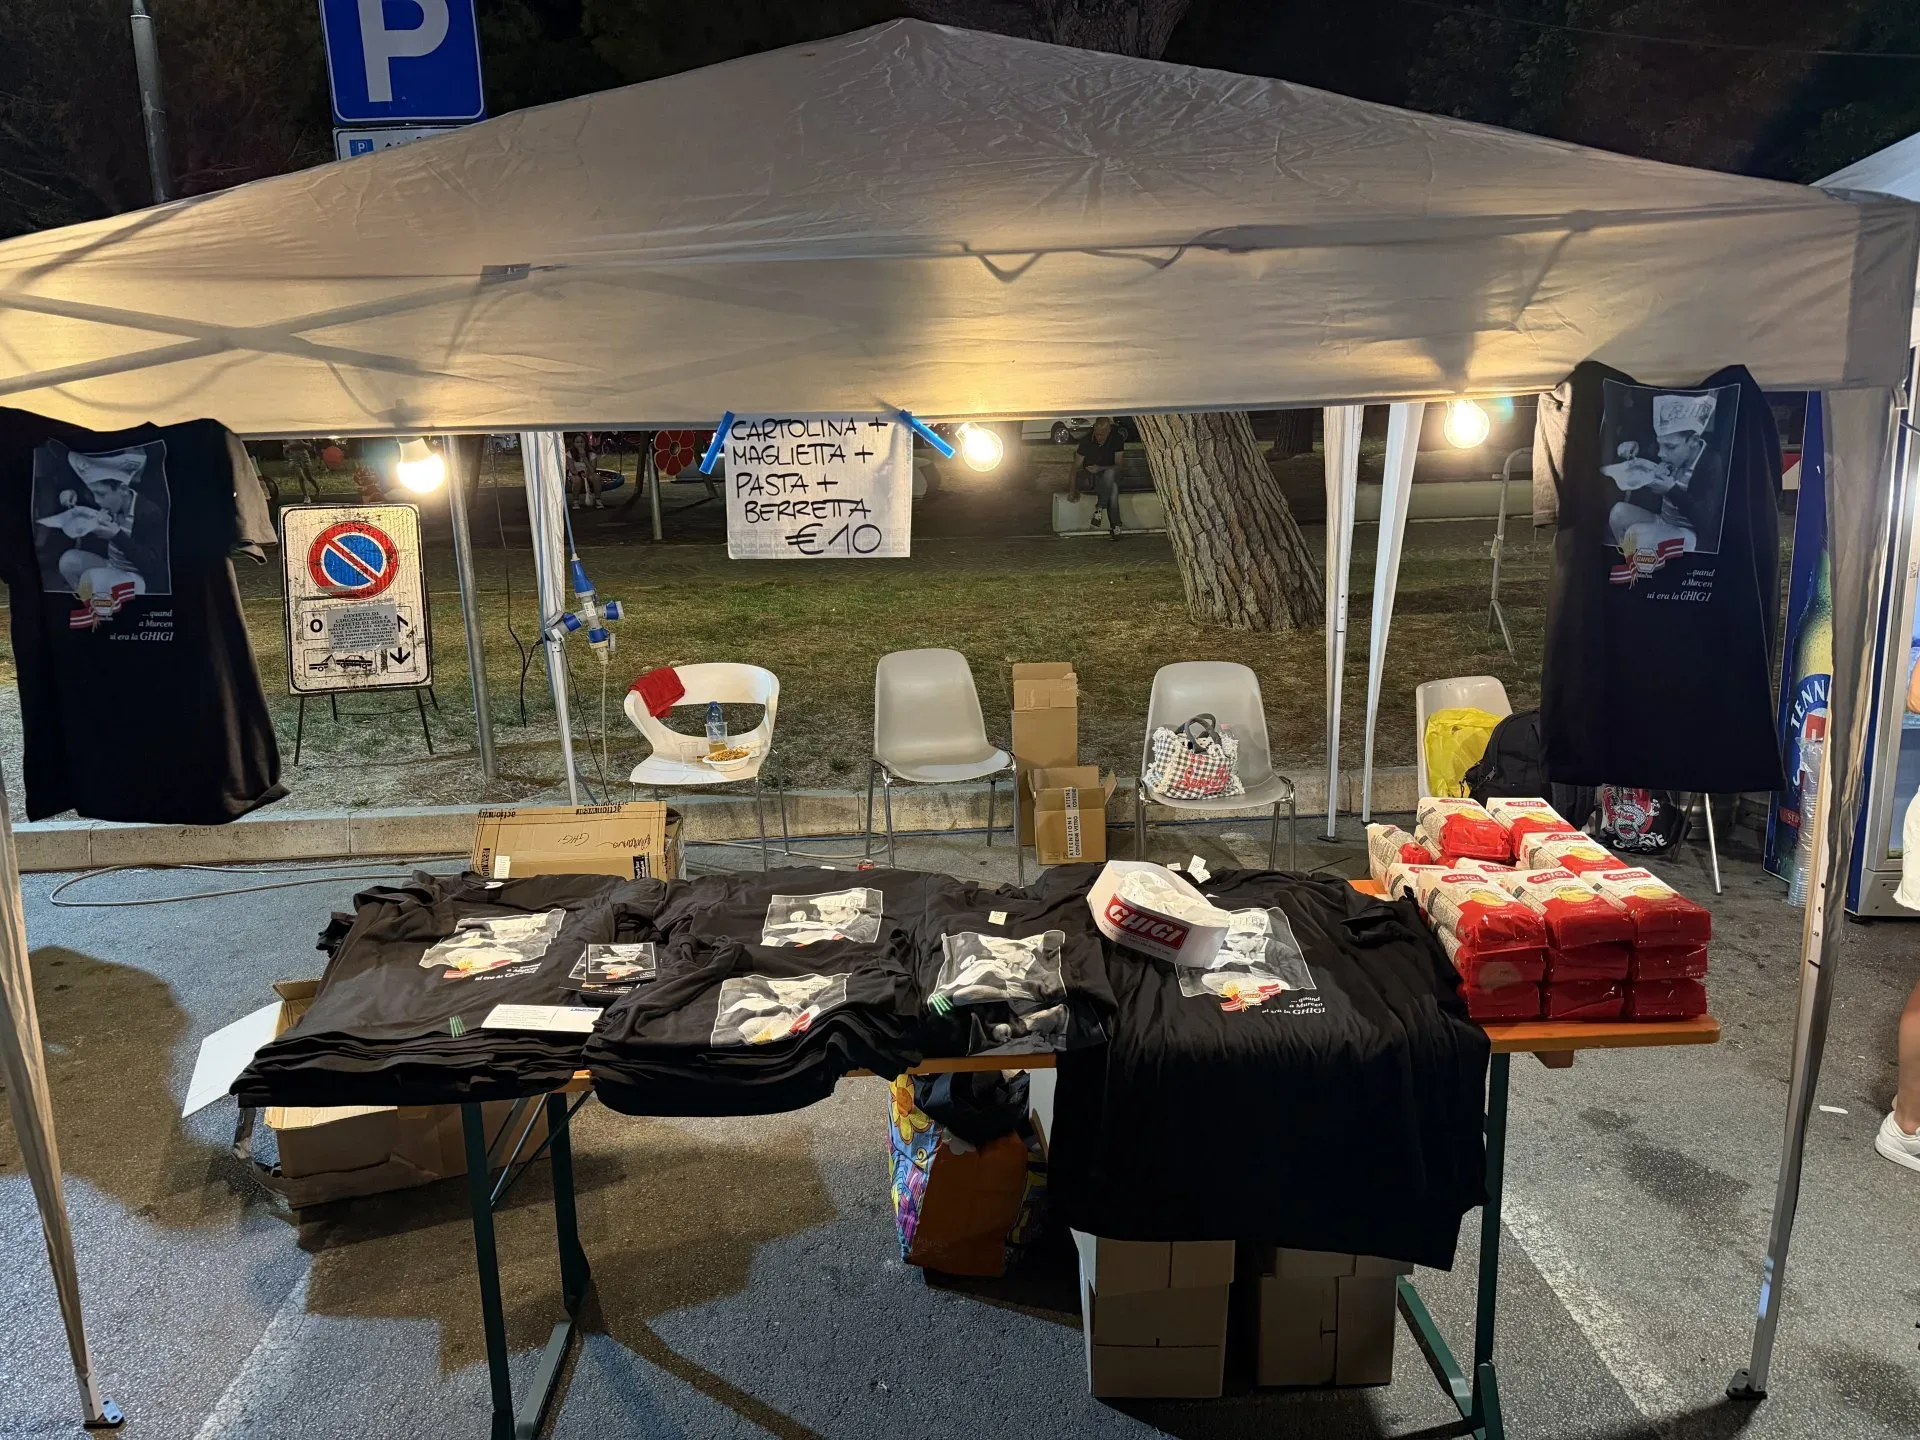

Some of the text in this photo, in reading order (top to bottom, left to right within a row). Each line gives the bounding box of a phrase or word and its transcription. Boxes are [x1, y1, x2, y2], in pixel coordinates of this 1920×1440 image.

[358, 0, 449, 102] P
[358, 142, 366, 152] P
[731, 417, 888, 442] CARTOLINA +
[732, 443, 874, 466] MAGLIETTA +
[736, 472, 838, 498] PASTA +
[744, 498, 871, 523] BERRETTA
[1680, 590, 1711, 602] GHIGI
[336, 615, 383, 623] CIRCOLAZIONE
[140, 632, 174, 641] GHIGI
[1791, 679, 1829, 732] TENN
[1533, 872, 1567, 882] GHIGI
[1609, 872, 1644, 880] GHIGI
[1109, 904, 1184, 942] GHIGI
